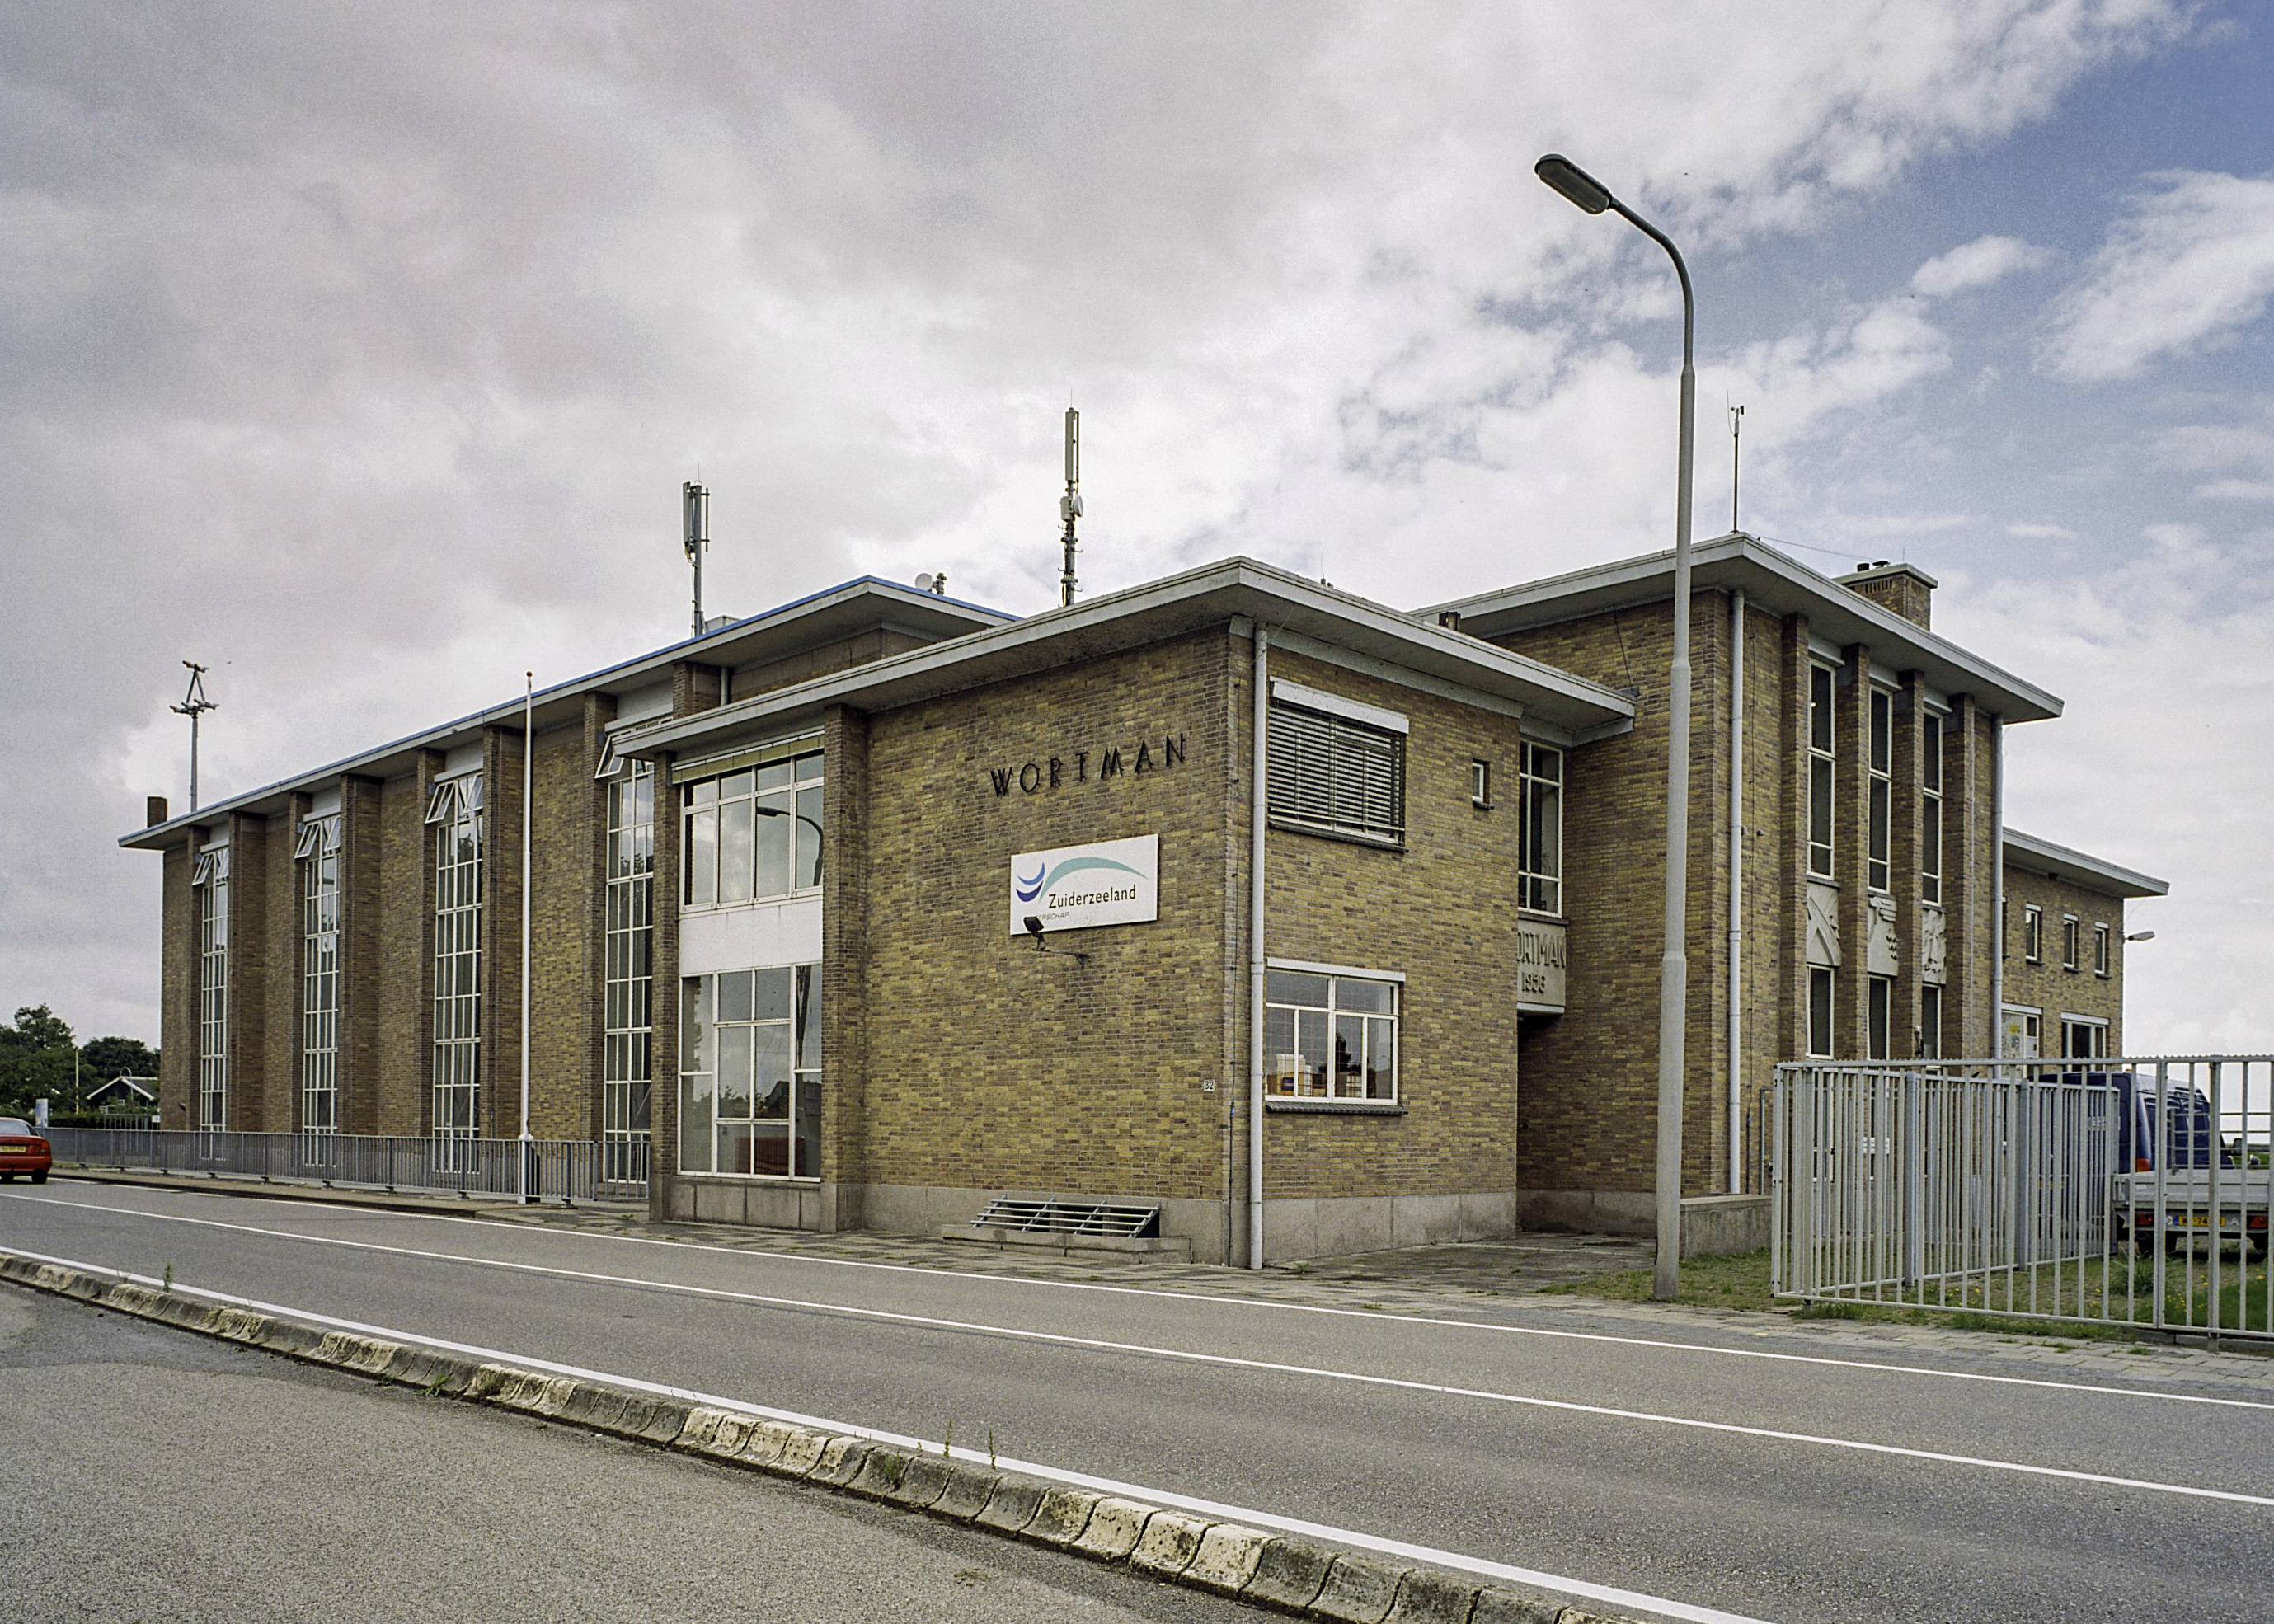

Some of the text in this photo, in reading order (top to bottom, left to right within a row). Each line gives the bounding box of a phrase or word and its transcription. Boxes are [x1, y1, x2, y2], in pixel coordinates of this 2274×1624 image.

[990, 733, 1186, 797] WORTMAN
[1048, 884, 1136, 908] Zuiderzeeland
[1036, 912, 1070, 921] ERSCHAP
